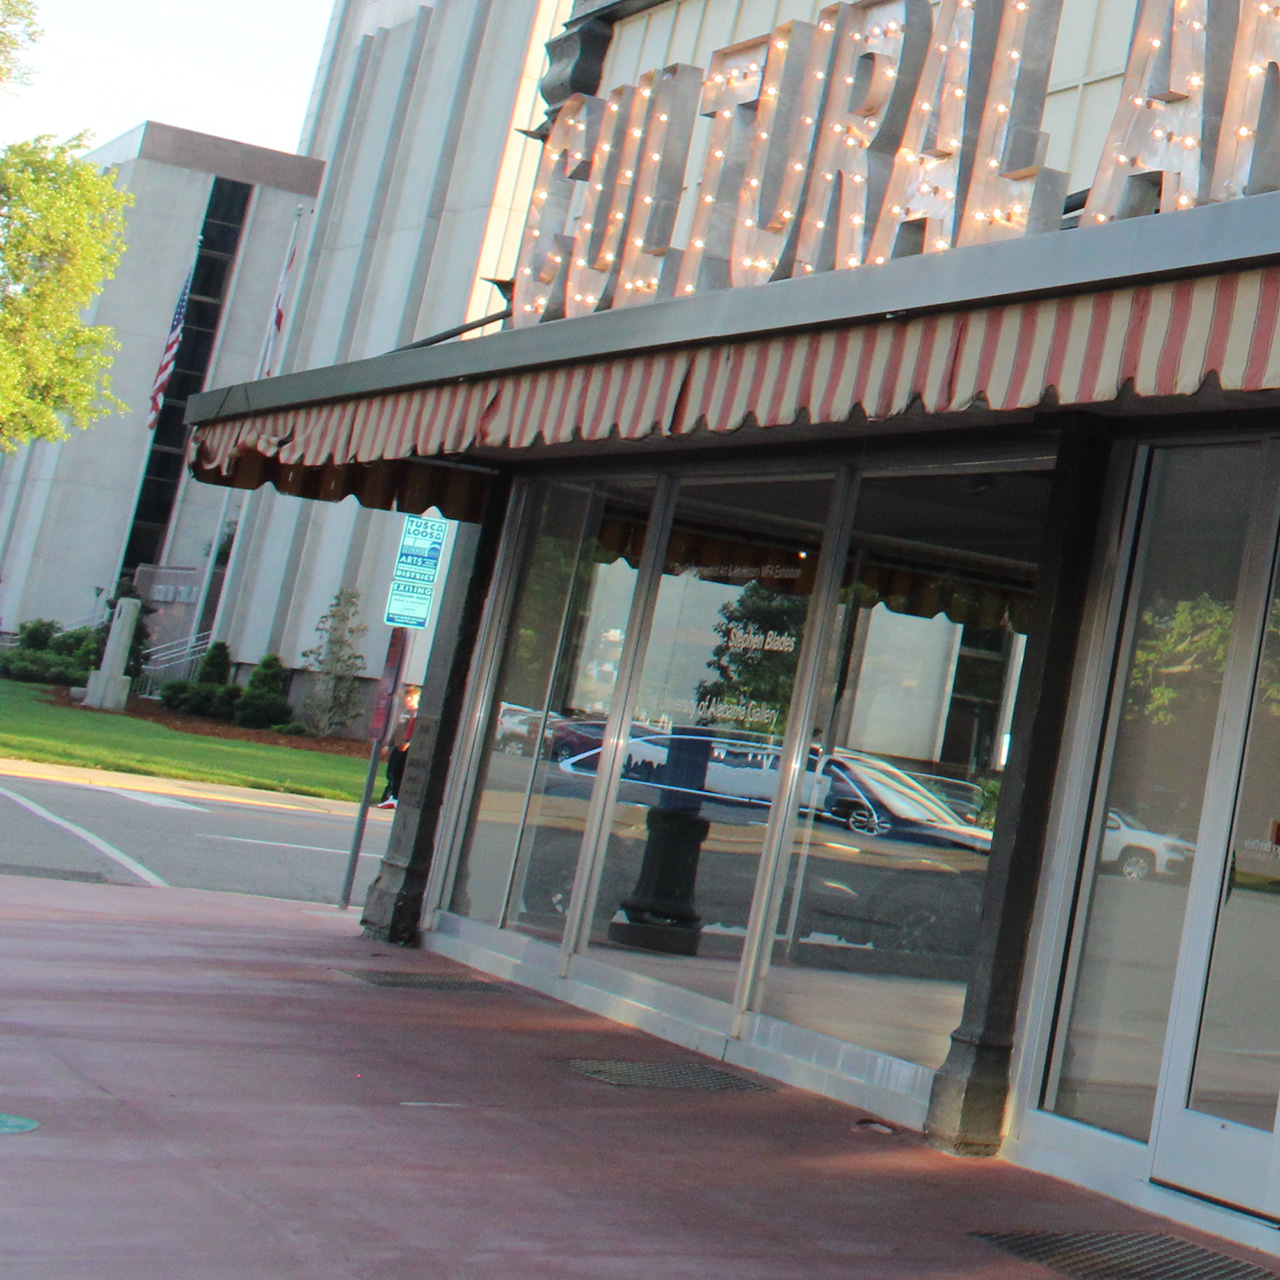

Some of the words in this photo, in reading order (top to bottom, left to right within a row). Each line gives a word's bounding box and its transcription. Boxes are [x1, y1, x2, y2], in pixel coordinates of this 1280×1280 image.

[409, 519, 443, 532] TUSCA
[407, 528, 441, 540] LOOSA
[400, 555, 423, 565] ARTS
[396, 570, 434, 581] DISTRICT
[728, 629, 764, 650] Stephen
[764, 630, 797, 651] Blades
